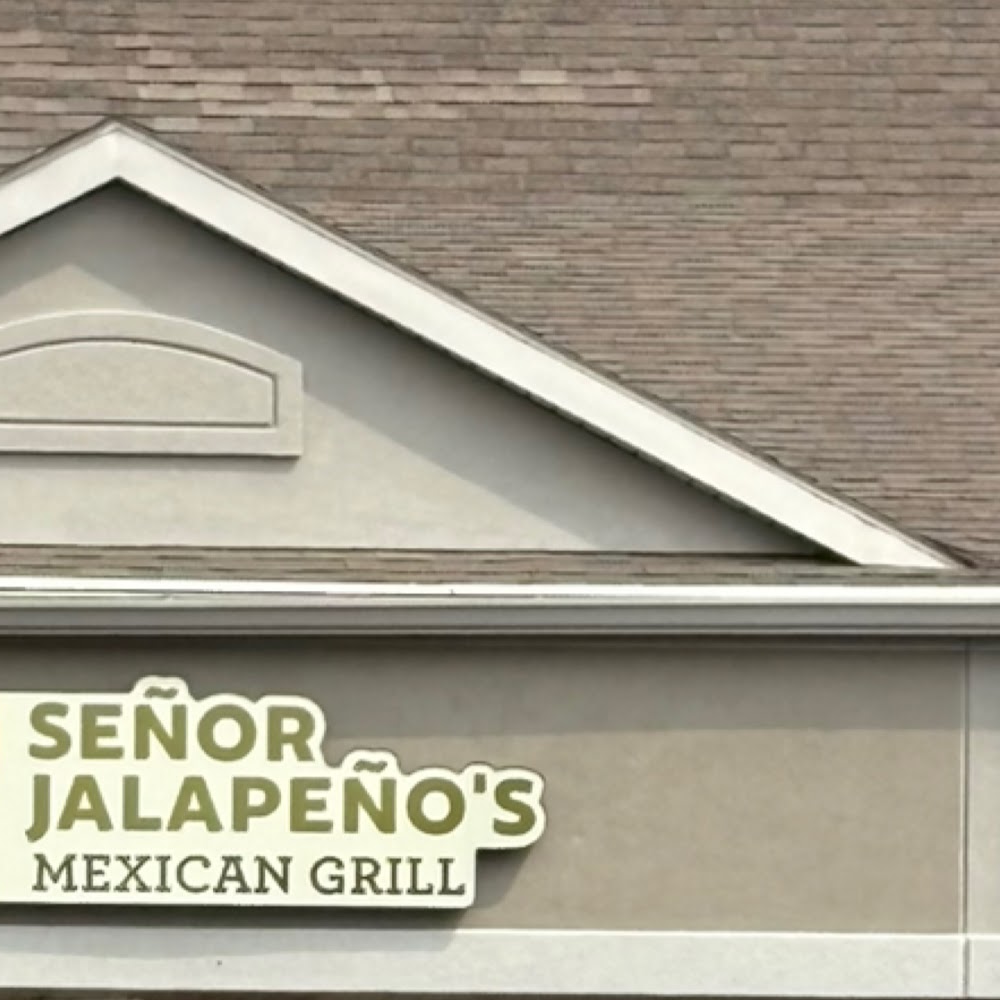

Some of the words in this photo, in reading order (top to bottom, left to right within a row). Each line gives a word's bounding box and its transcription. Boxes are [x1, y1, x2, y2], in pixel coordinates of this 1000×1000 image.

[28, 686, 319, 763] SEÑOR
[25, 759, 538, 844] JALAPEÑO'S
[32, 853, 292, 895] MEXICAN
[309, 856, 466, 897] GRILL
